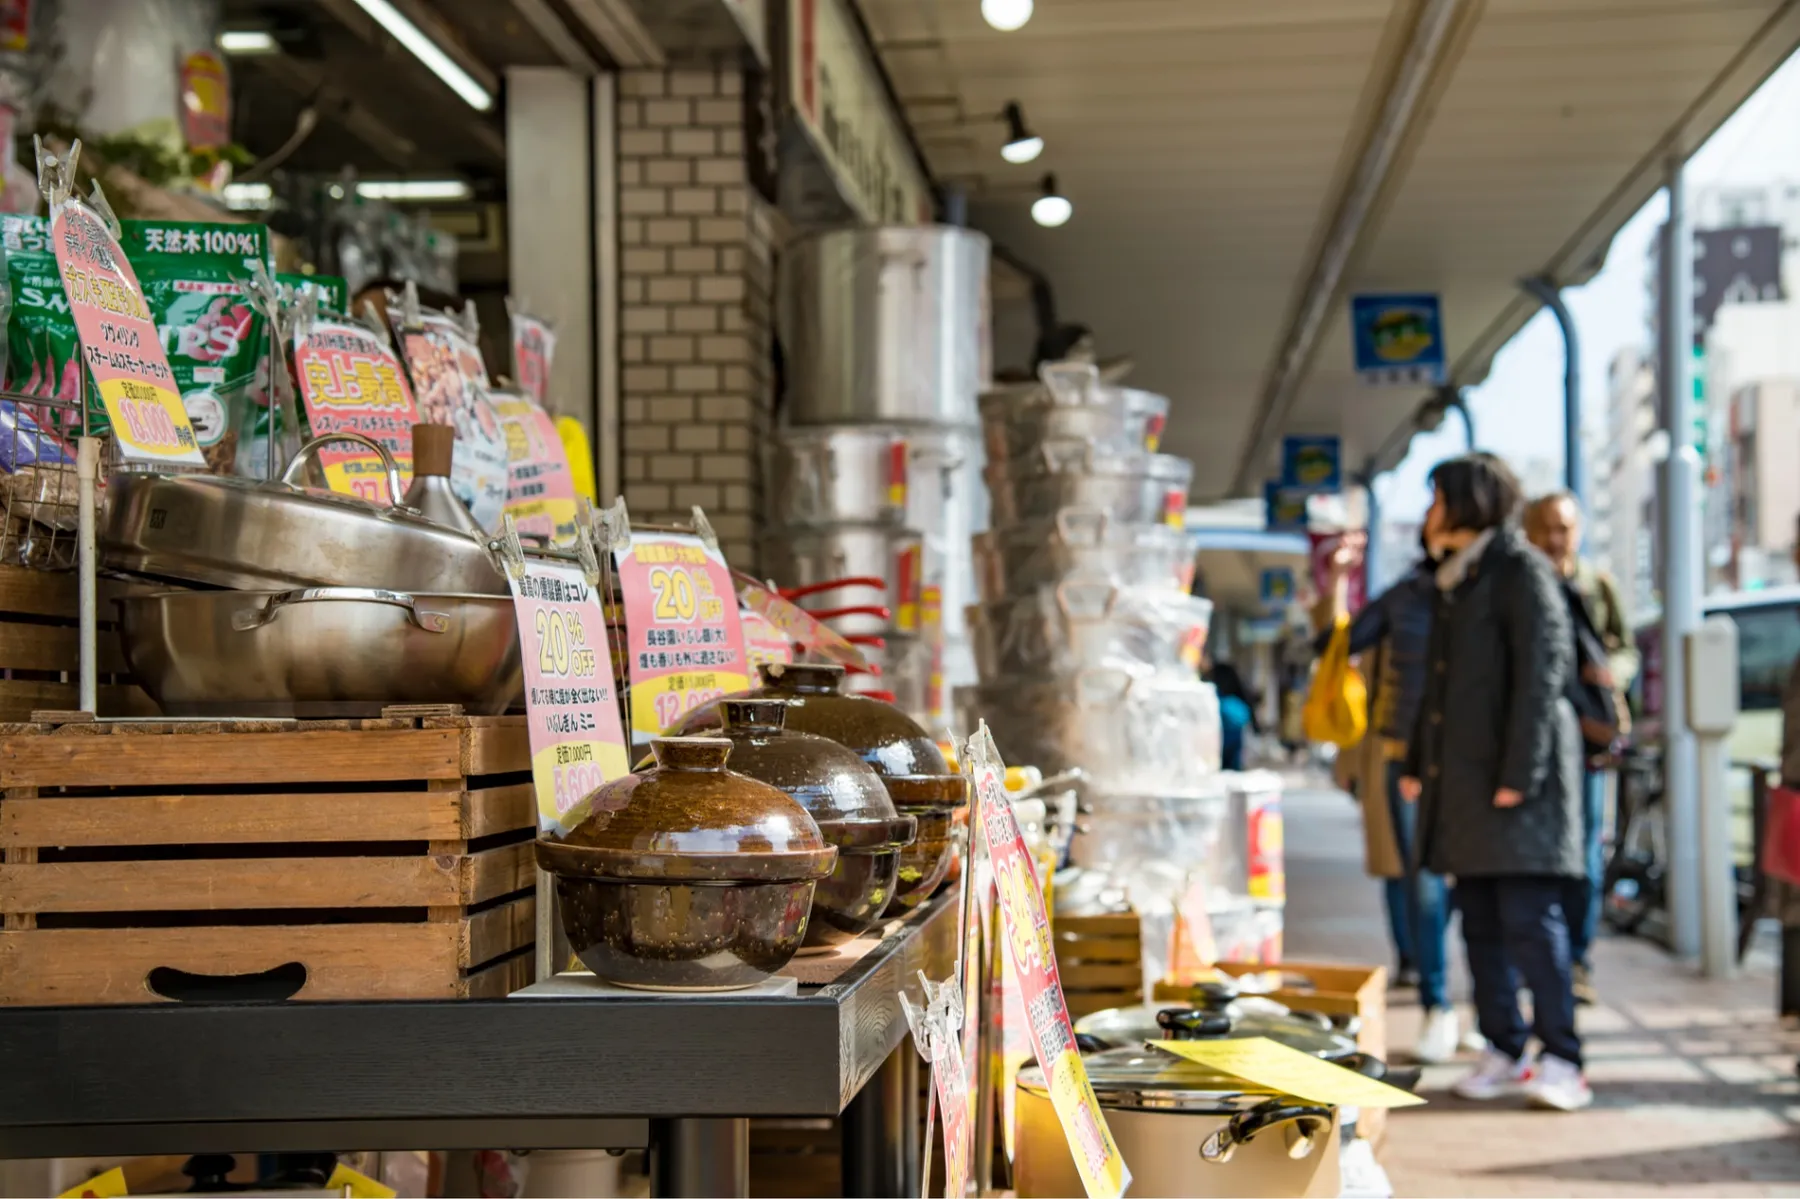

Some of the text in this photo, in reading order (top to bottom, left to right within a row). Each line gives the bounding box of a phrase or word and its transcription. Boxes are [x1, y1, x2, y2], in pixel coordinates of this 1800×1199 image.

[145, 228, 260, 254] 天然木100%!
[304, 356, 409, 409] 史上最高
[570, 649, 596, 676] OFF
[545, 712, 596, 733] いぶしぎん ミニ
